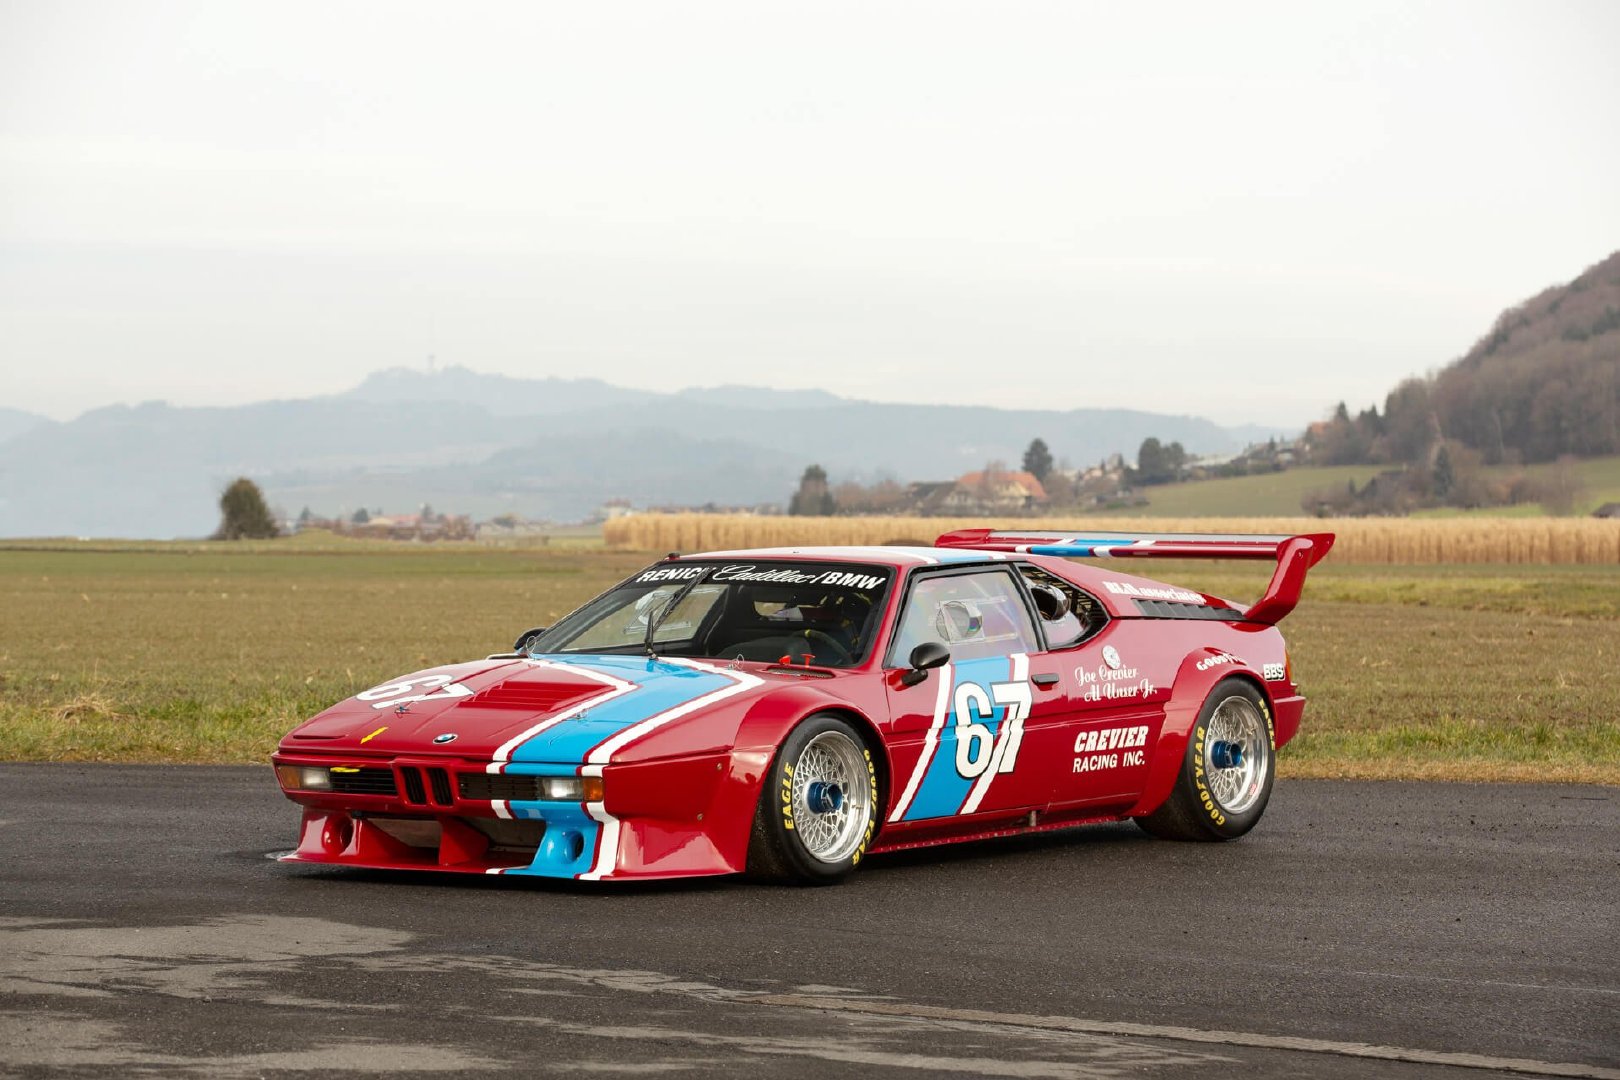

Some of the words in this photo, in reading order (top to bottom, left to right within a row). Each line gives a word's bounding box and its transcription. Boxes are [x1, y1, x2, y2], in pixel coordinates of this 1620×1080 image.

[636, 567, 716, 583] RENIC
[1074, 666, 1096, 687] Joe
[1098, 664, 1139, 681] Crevier
[1263, 663, 1285, 681] BBS
[356, 674, 475, 709] 67
[1084, 684, 1102, 702] Al
[1102, 682, 1139, 700] Unser
[1139, 678, 1157, 699] Jr.
[953, 681, 1032, 781] 67
[1074, 725, 1149, 753] CREVIER
[1072, 753, 1118, 773] RACING
[1122, 750, 1146, 767] INC.
[782, 761, 795, 830] EAGLE
